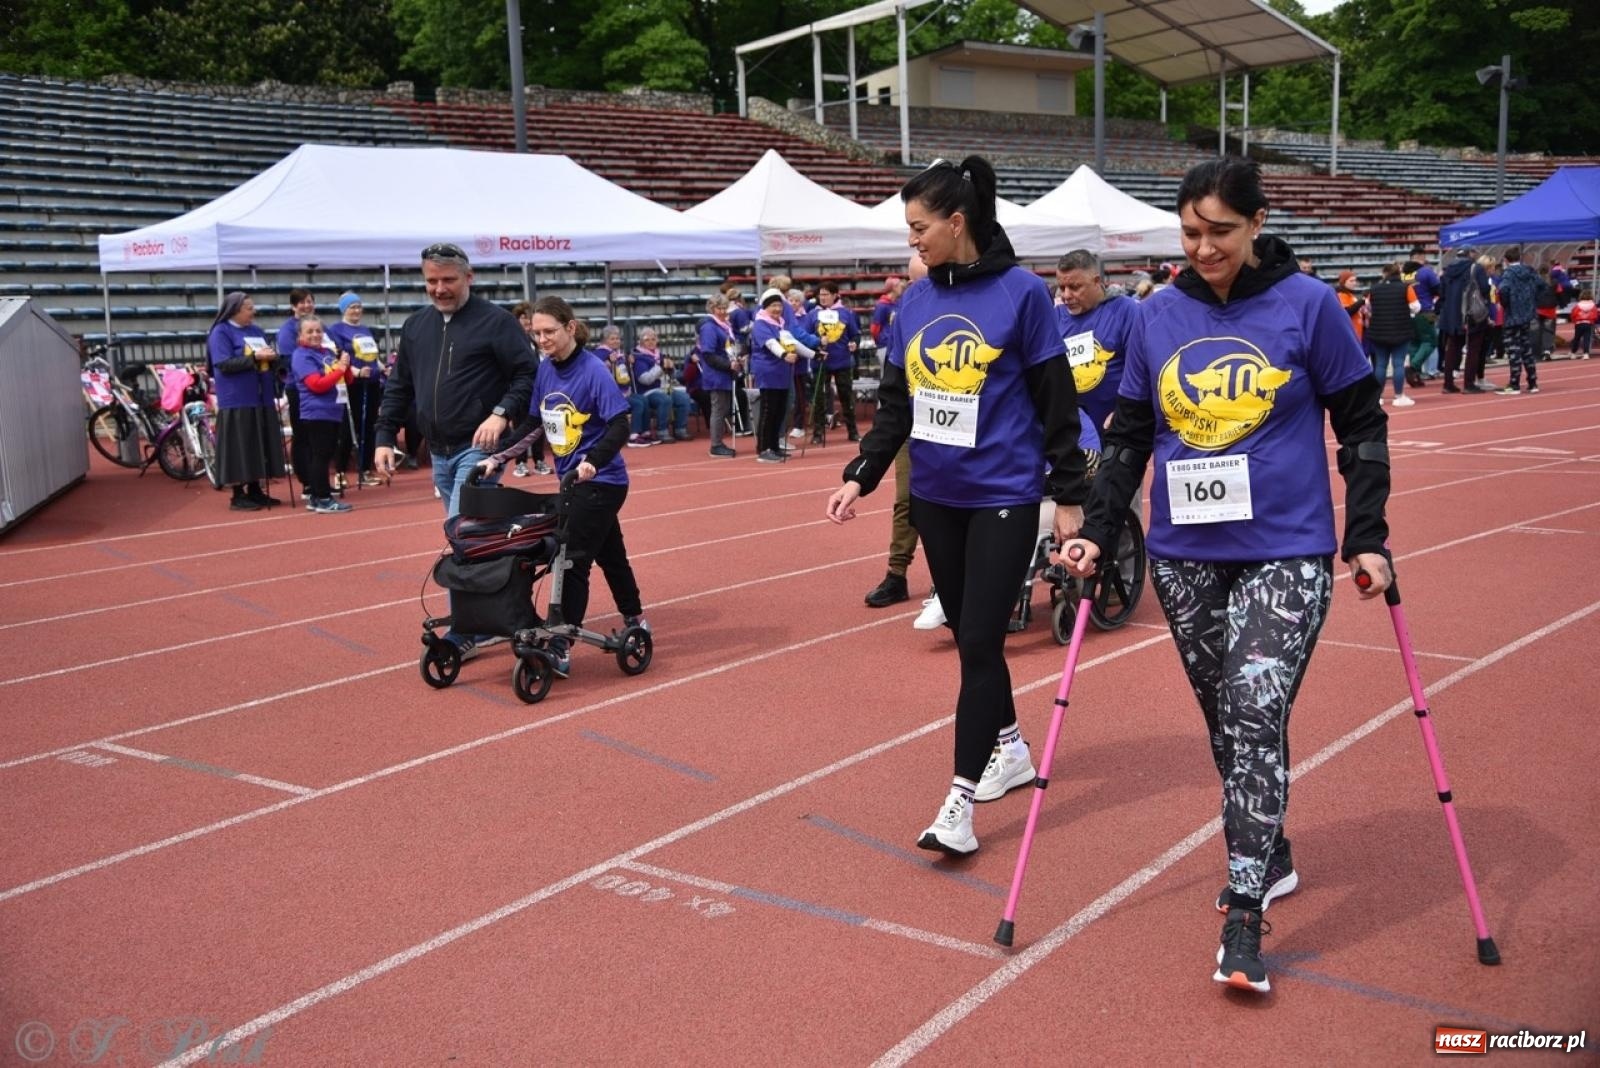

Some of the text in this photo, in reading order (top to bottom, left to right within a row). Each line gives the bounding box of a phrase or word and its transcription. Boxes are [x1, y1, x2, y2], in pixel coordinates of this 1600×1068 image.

[499, 235, 571, 250] Racibórz
[949, 340, 976, 371] 10
[1215, 363, 1259, 399] 10
[929, 408, 959, 427] 107
[1209, 459, 1240, 469] BARIER
[1185, 479, 1226, 502] 160
